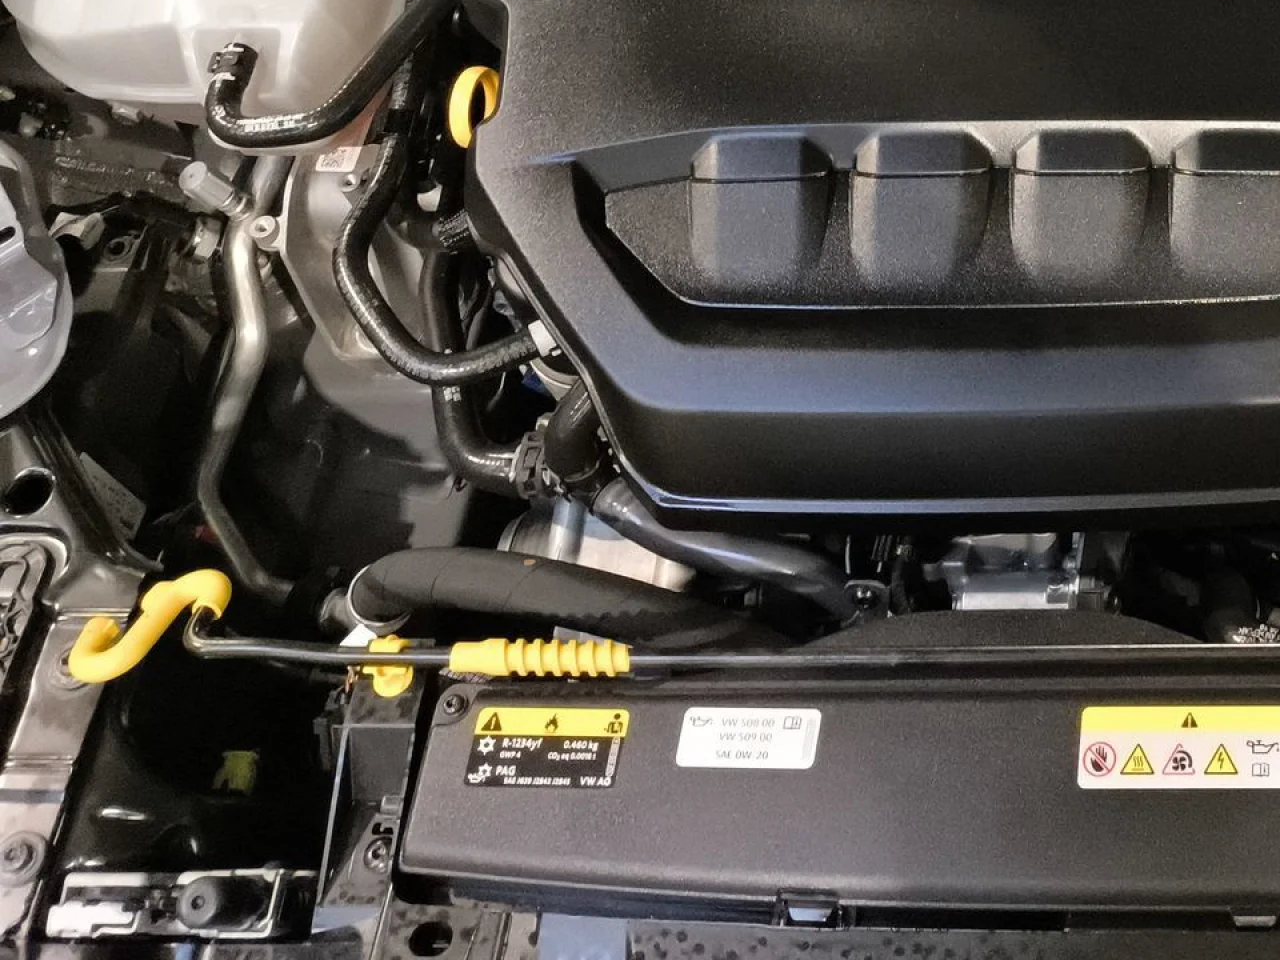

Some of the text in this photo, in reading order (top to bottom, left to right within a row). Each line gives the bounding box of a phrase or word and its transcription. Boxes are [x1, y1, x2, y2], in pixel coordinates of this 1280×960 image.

[722, 717, 738, 728] VW
[762, 718, 776, 728] 00
[719, 732, 737, 741] VW
[759, 732, 773, 742] 00
[715, 750, 733, 760] SAE
[495, 765, 517, 777] PAG
[580, 775, 597, 786] VW
